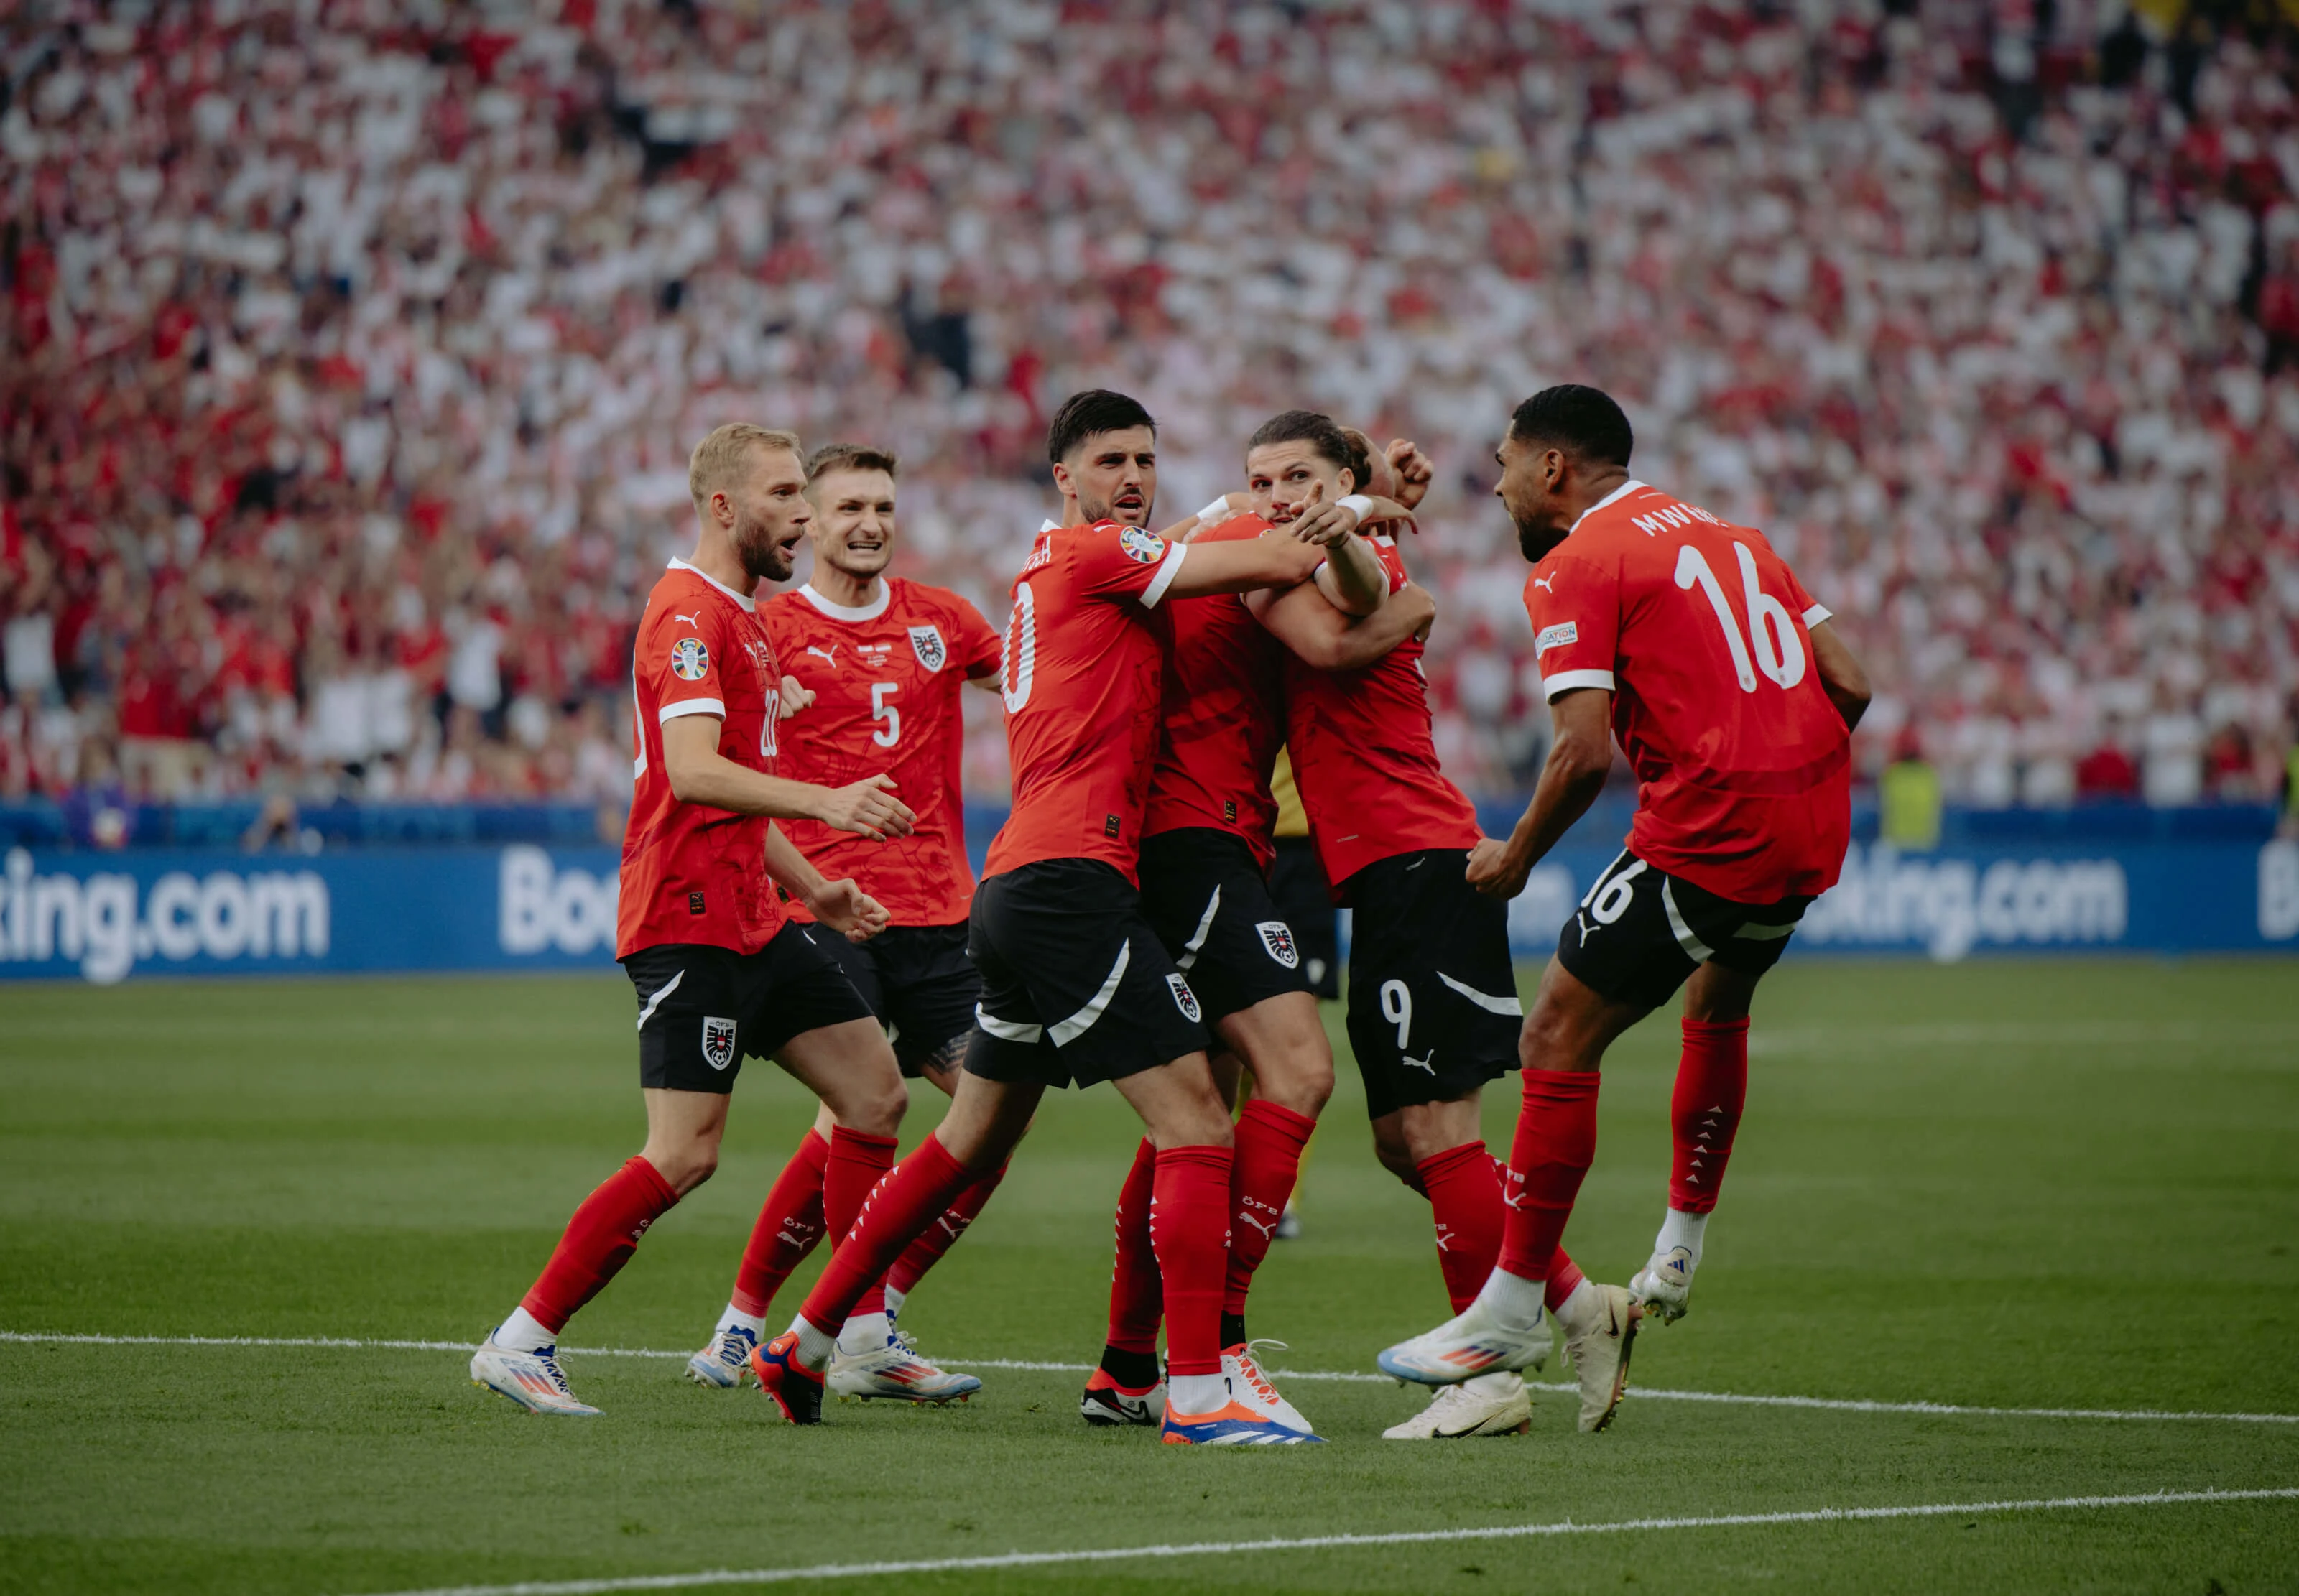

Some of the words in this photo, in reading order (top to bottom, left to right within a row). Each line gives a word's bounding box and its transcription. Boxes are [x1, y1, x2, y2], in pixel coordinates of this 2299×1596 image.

[1000, 582, 1036, 713] 0
[1674, 541, 1806, 693] 16
[761, 690, 779, 756] 20
[871, 682, 901, 747] 5
[0, 848, 331, 984] ing.com
[1581, 847, 1647, 924] 16
[1379, 979, 1412, 1049] 9
[782, 1217, 815, 1232] ÖFB
[1241, 1195, 1278, 1215] ÖFB
